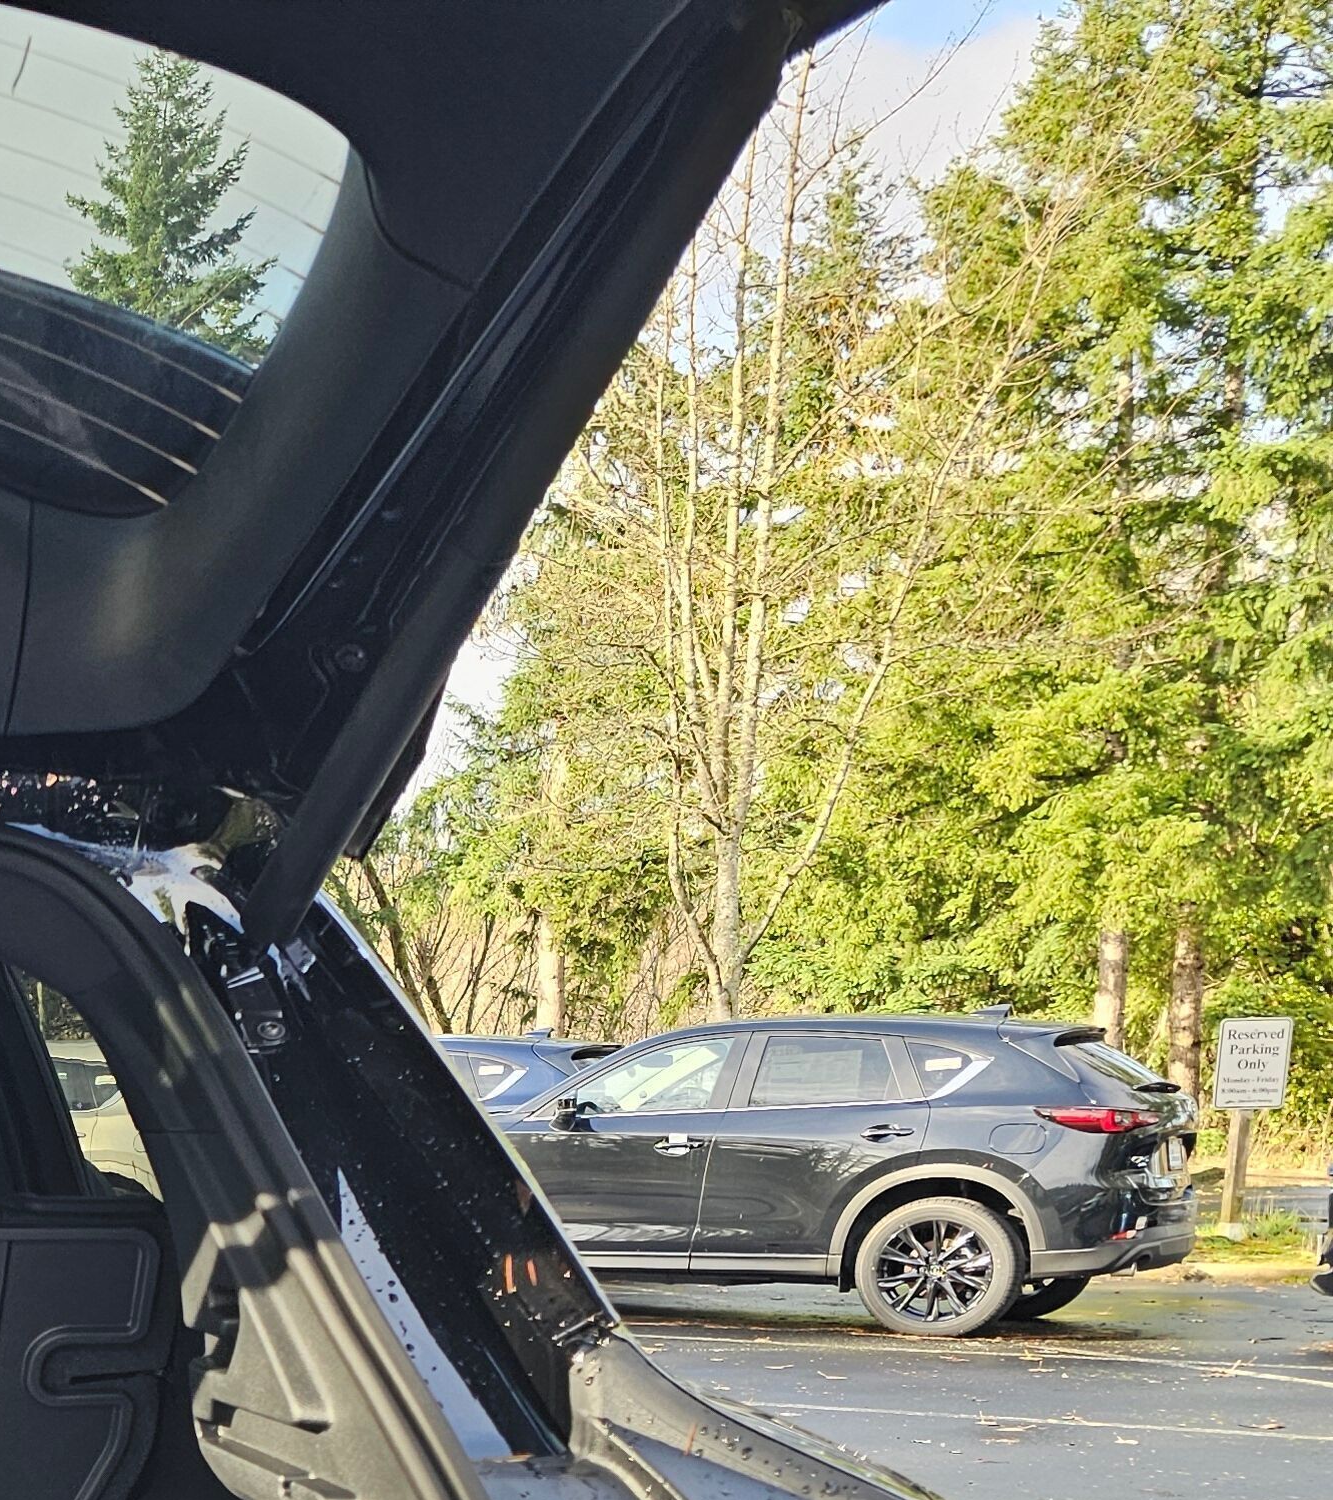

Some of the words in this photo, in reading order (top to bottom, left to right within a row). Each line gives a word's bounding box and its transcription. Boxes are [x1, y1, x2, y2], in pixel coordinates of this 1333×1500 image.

[1228, 1028, 1285, 1040] Reserved
[1230, 1044, 1280, 1056] Parking
[1237, 1058, 1268, 1072] Only
